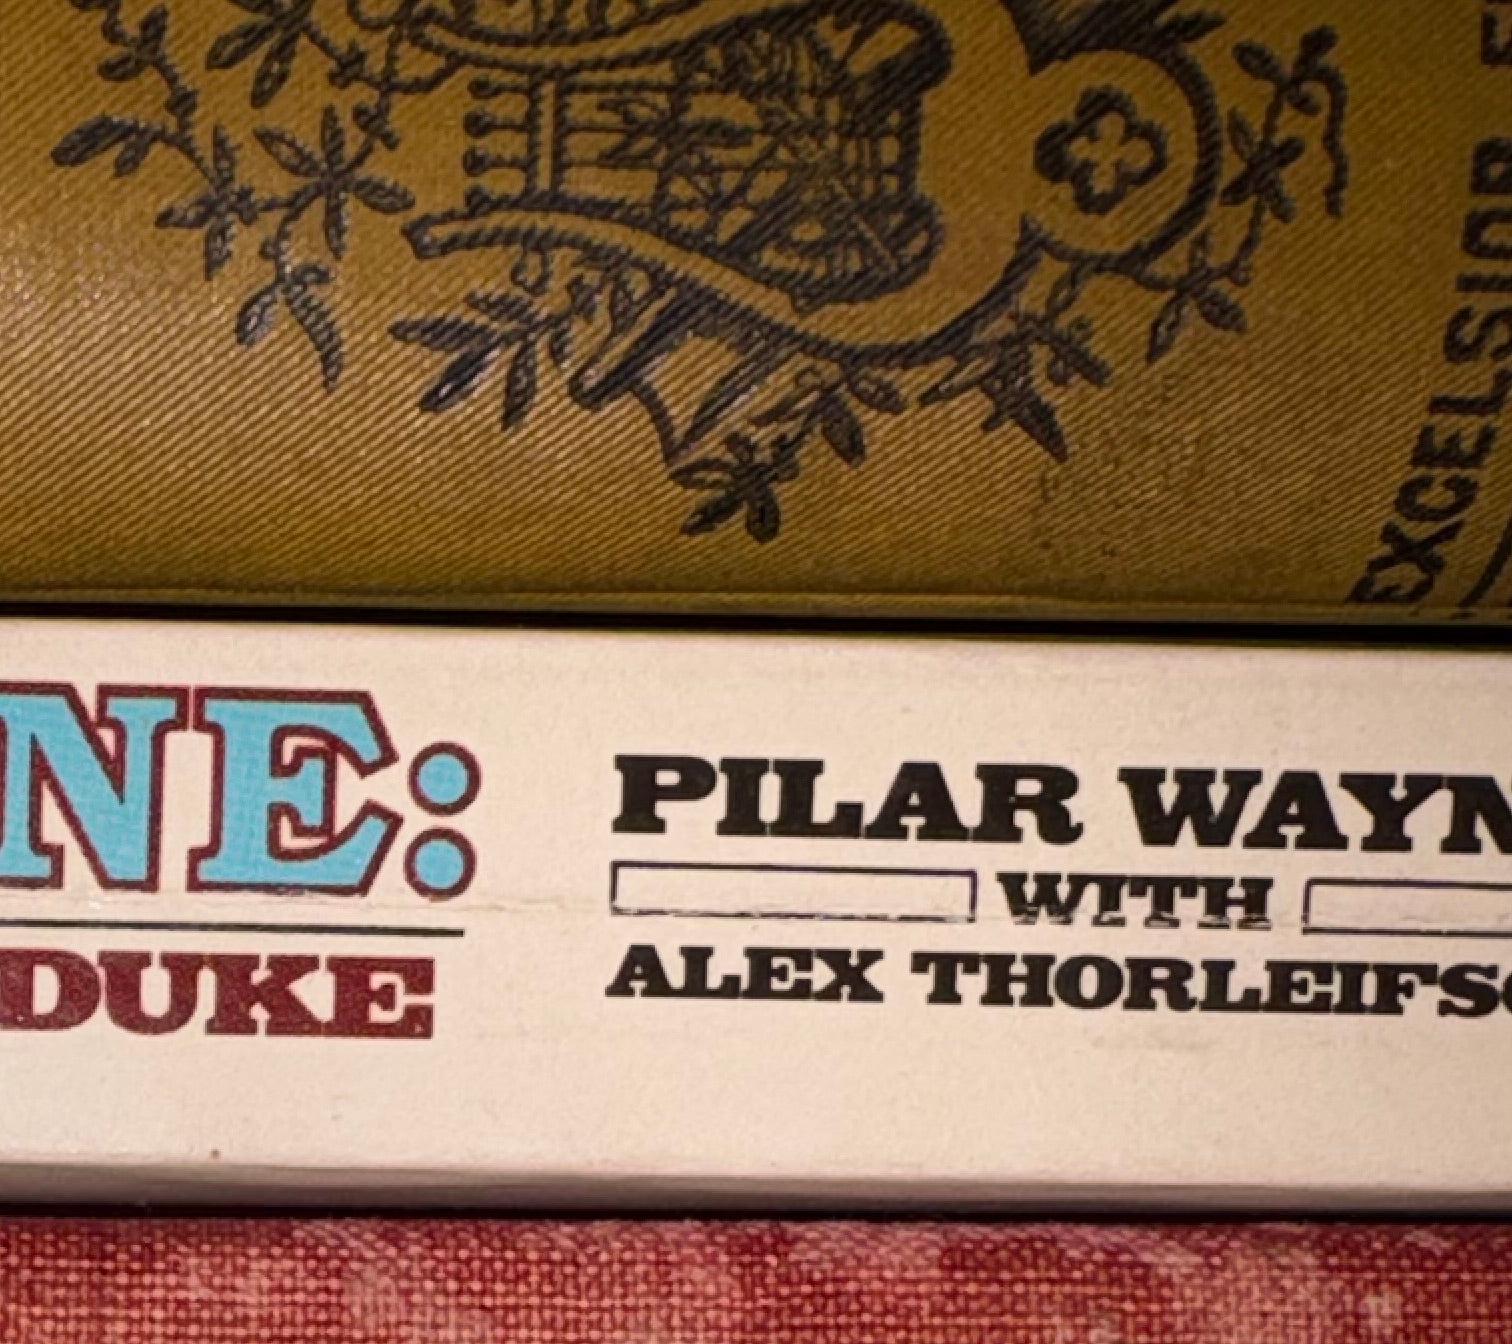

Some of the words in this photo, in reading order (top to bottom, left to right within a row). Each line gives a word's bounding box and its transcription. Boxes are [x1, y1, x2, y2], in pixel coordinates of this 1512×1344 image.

[612, 753, 1084, 846] PILAR
[1118, 767, 1512, 855] WAYN
[997, 871, 1275, 931] WITH
[605, 944, 884, 1004] ALEX
[910, 951, 1512, 1018] THORLEIFS
